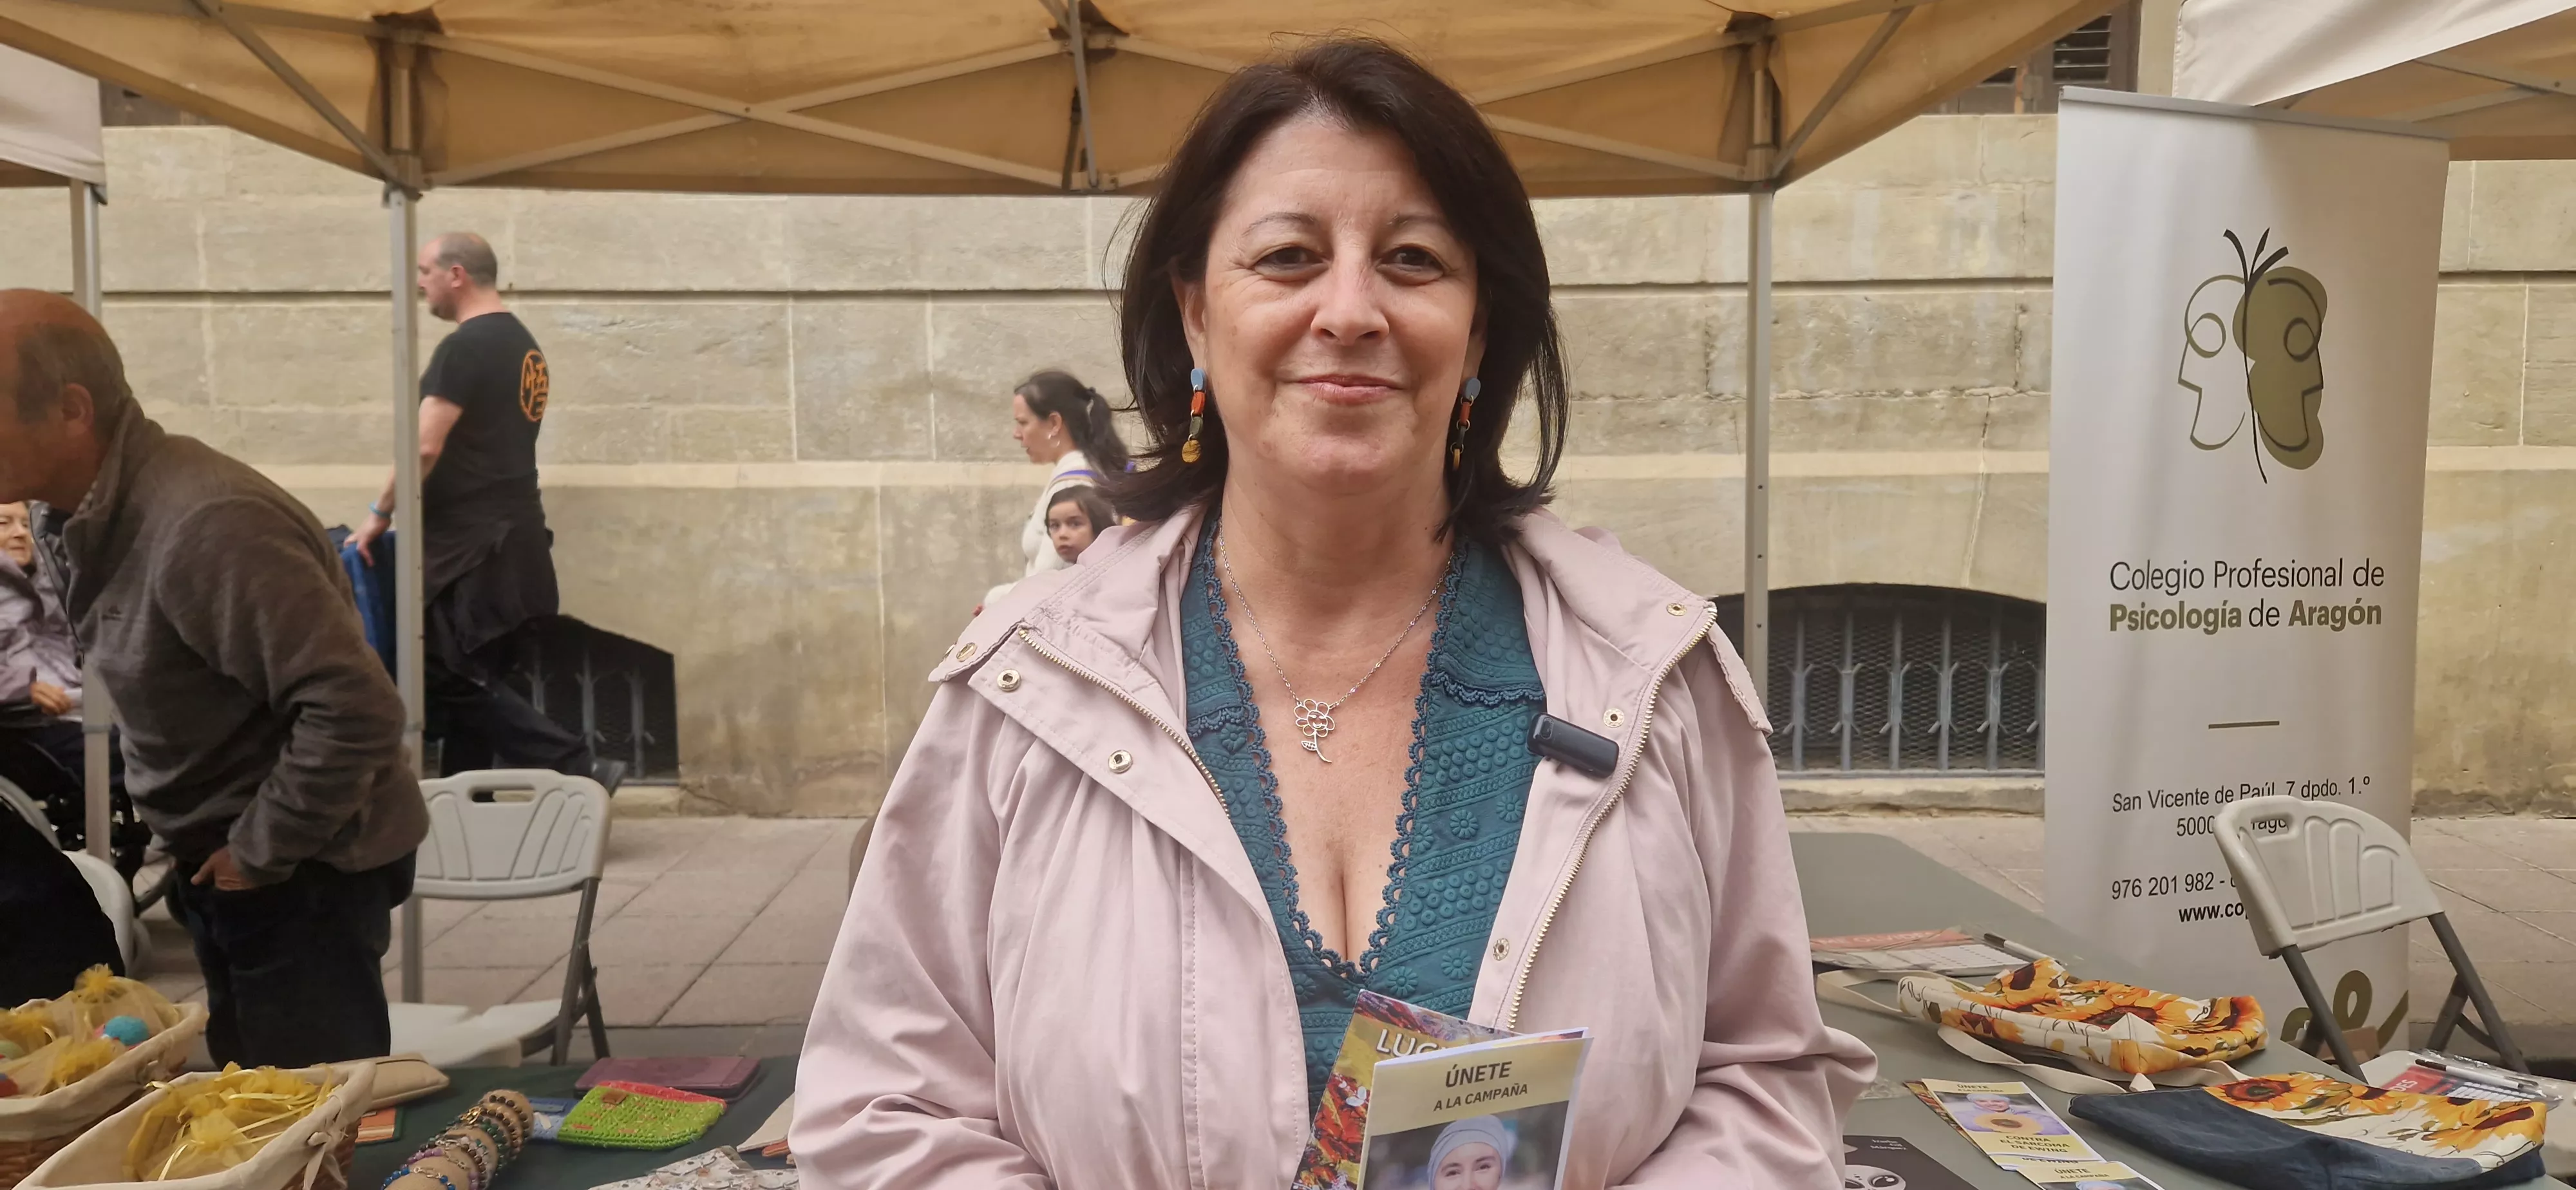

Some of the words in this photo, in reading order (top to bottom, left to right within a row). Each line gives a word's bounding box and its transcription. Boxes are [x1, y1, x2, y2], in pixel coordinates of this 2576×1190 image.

[2110, 559, 2204, 596] Colegio
[2214, 558, 2343, 589] Profesional
[2353, 558, 2384, 587] de
[2110, 600, 2242, 635] Psicología
[2249, 598, 2280, 627] de
[2287, 598, 2382, 632] Aragón
[2112, 793, 2141, 812] San
[2147, 789, 2209, 809] Vicente
[2215, 785, 2234, 804] de
[2286, 781, 2295, 796] 7
[2301, 779, 2341, 801] dpdo.
[2176, 815, 2215, 836] 5000
[2112, 880, 2142, 900] 976
[2148, 875, 2177, 896] 201
[2184, 871, 2214, 892] 982
[2179, 902, 2248, 923] www.co
[1376, 1028, 1446, 1057] LUC
[1445, 1061, 1512, 1088] ÚNETE
[1433, 1100, 1443, 1111] A
[1446, 1096, 1461, 1109] LA
[1465, 1083, 1528, 1105] CAMPAÑA
[2011, 1140, 2070, 1148] SARCOMA
